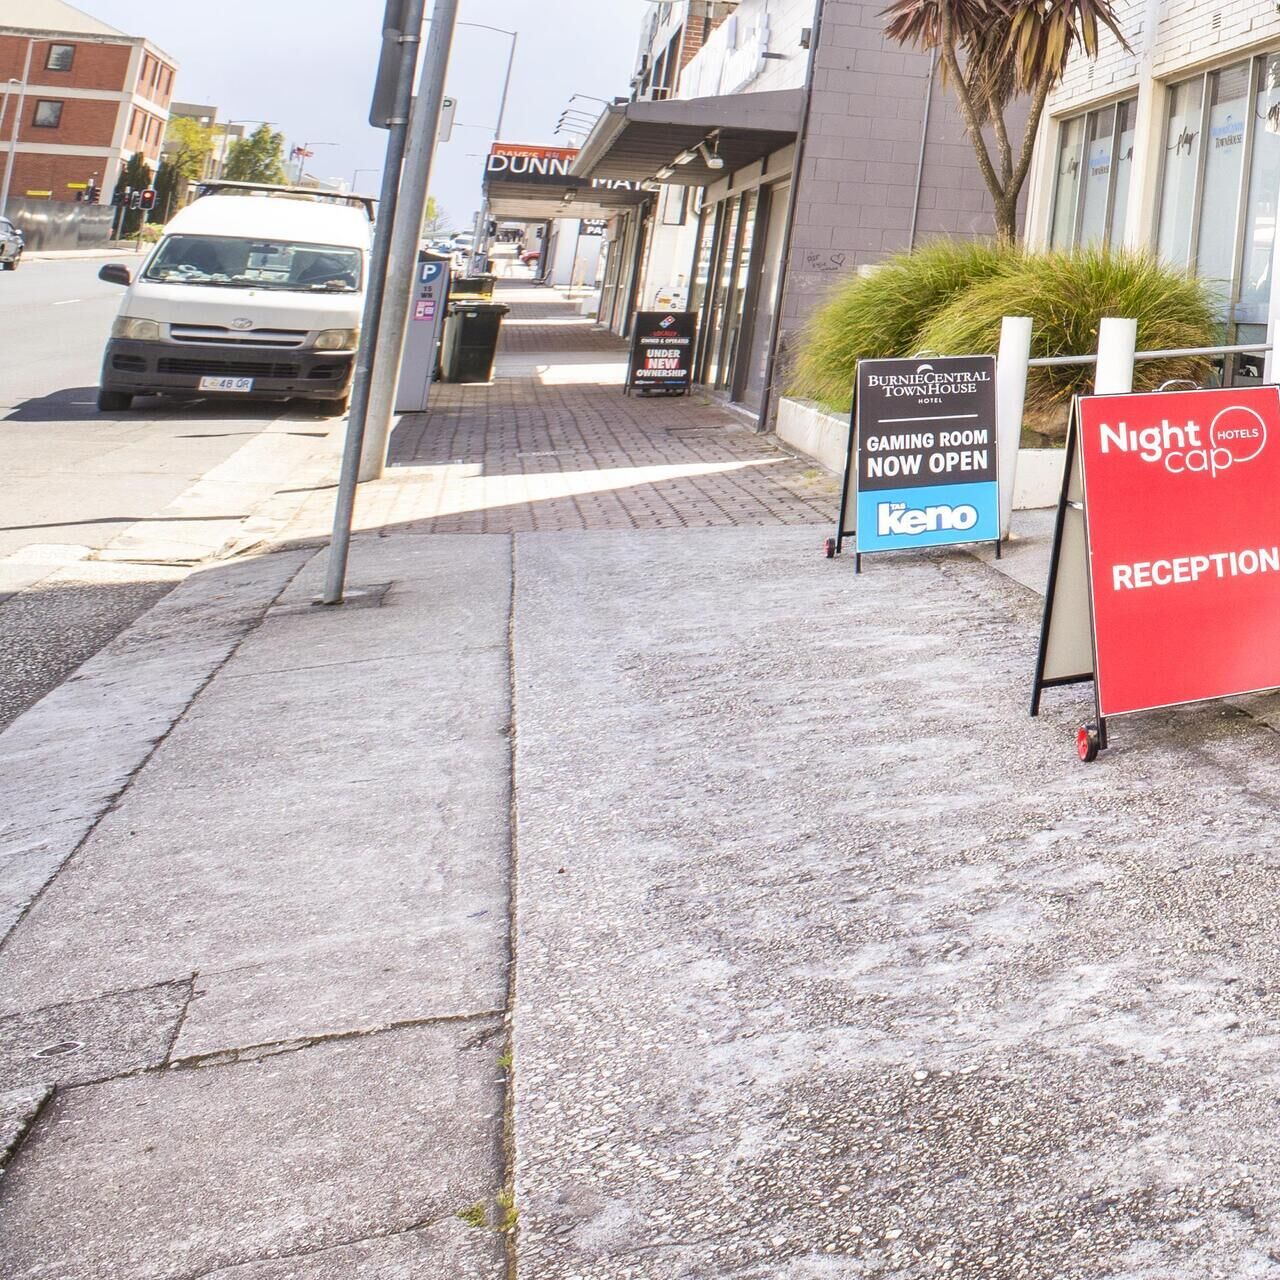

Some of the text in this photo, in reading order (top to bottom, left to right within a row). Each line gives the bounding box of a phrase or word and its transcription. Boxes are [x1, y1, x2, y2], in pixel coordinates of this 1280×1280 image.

[487, 154, 570, 175] DUNN
[422, 264, 437, 280] P
[646, 349, 681, 358] UNDER
[647, 358, 679, 369] NEW
[636, 369, 688, 377] OWNERSHIP
[866, 429, 988, 451] GAMING ROOM
[1099, 419, 1202, 462] Night
[1216, 426, 1259, 440] HOTELS
[867, 450, 988, 478] NOW OPEN
[1165, 445, 1232, 478] cap
[1112, 547, 1280, 591] RECEPTION
